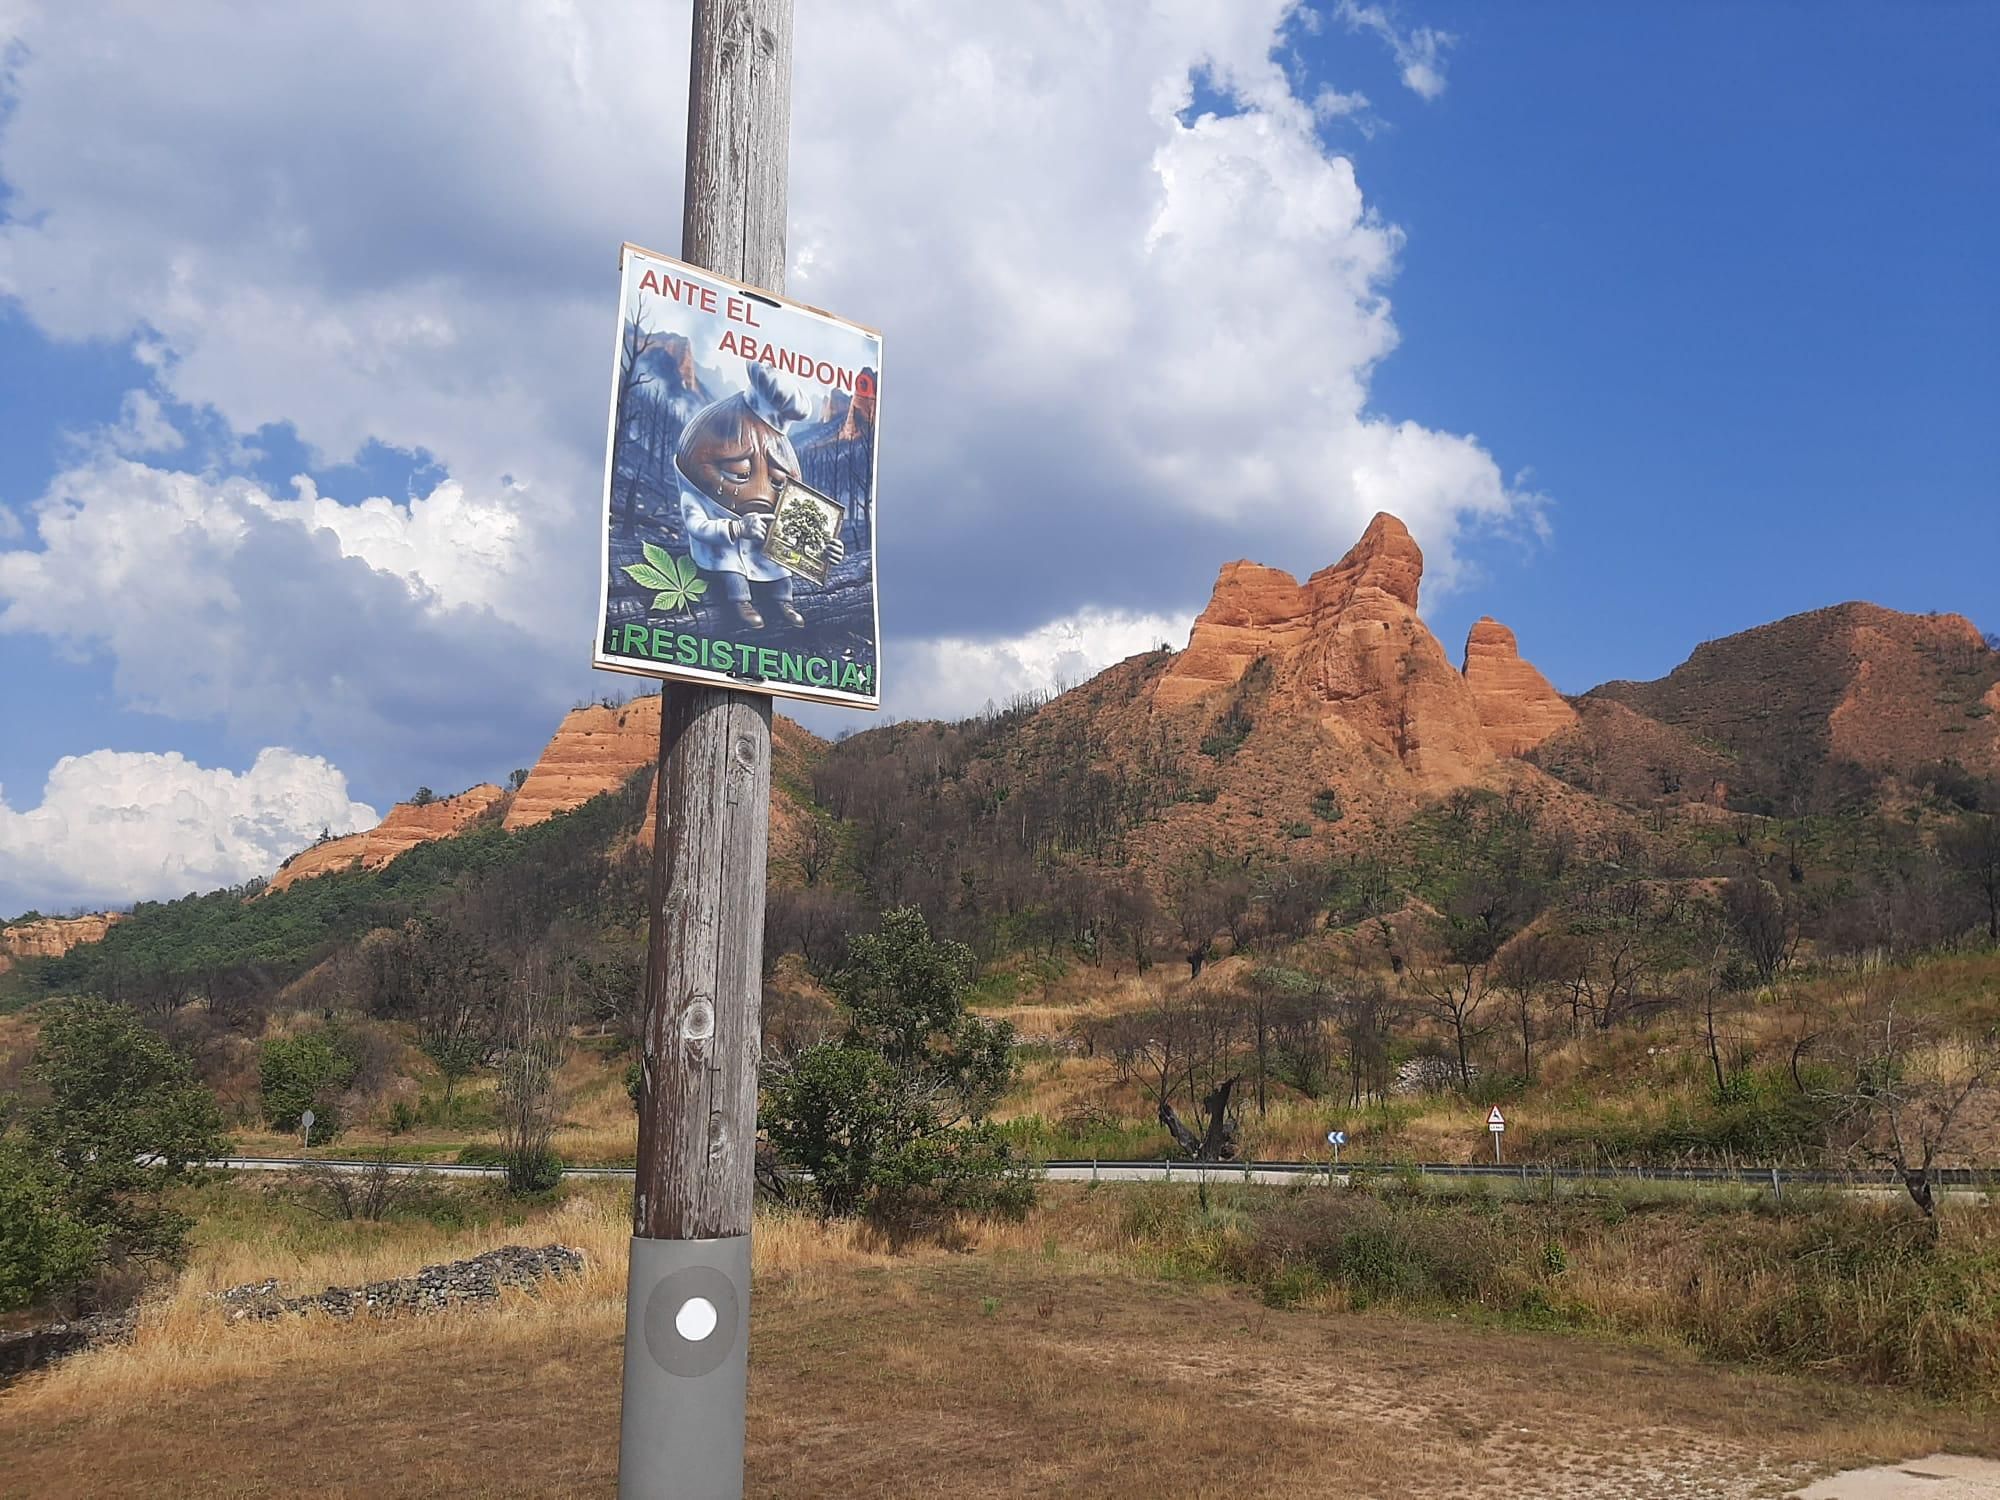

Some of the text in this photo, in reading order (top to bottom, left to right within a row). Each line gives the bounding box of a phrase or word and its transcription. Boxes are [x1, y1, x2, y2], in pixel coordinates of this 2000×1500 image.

[639, 269, 760, 328] ANTE EL
[718, 330, 875, 398] ABANDONO
[610, 623, 872, 694] ¡RESISTENCIA!
